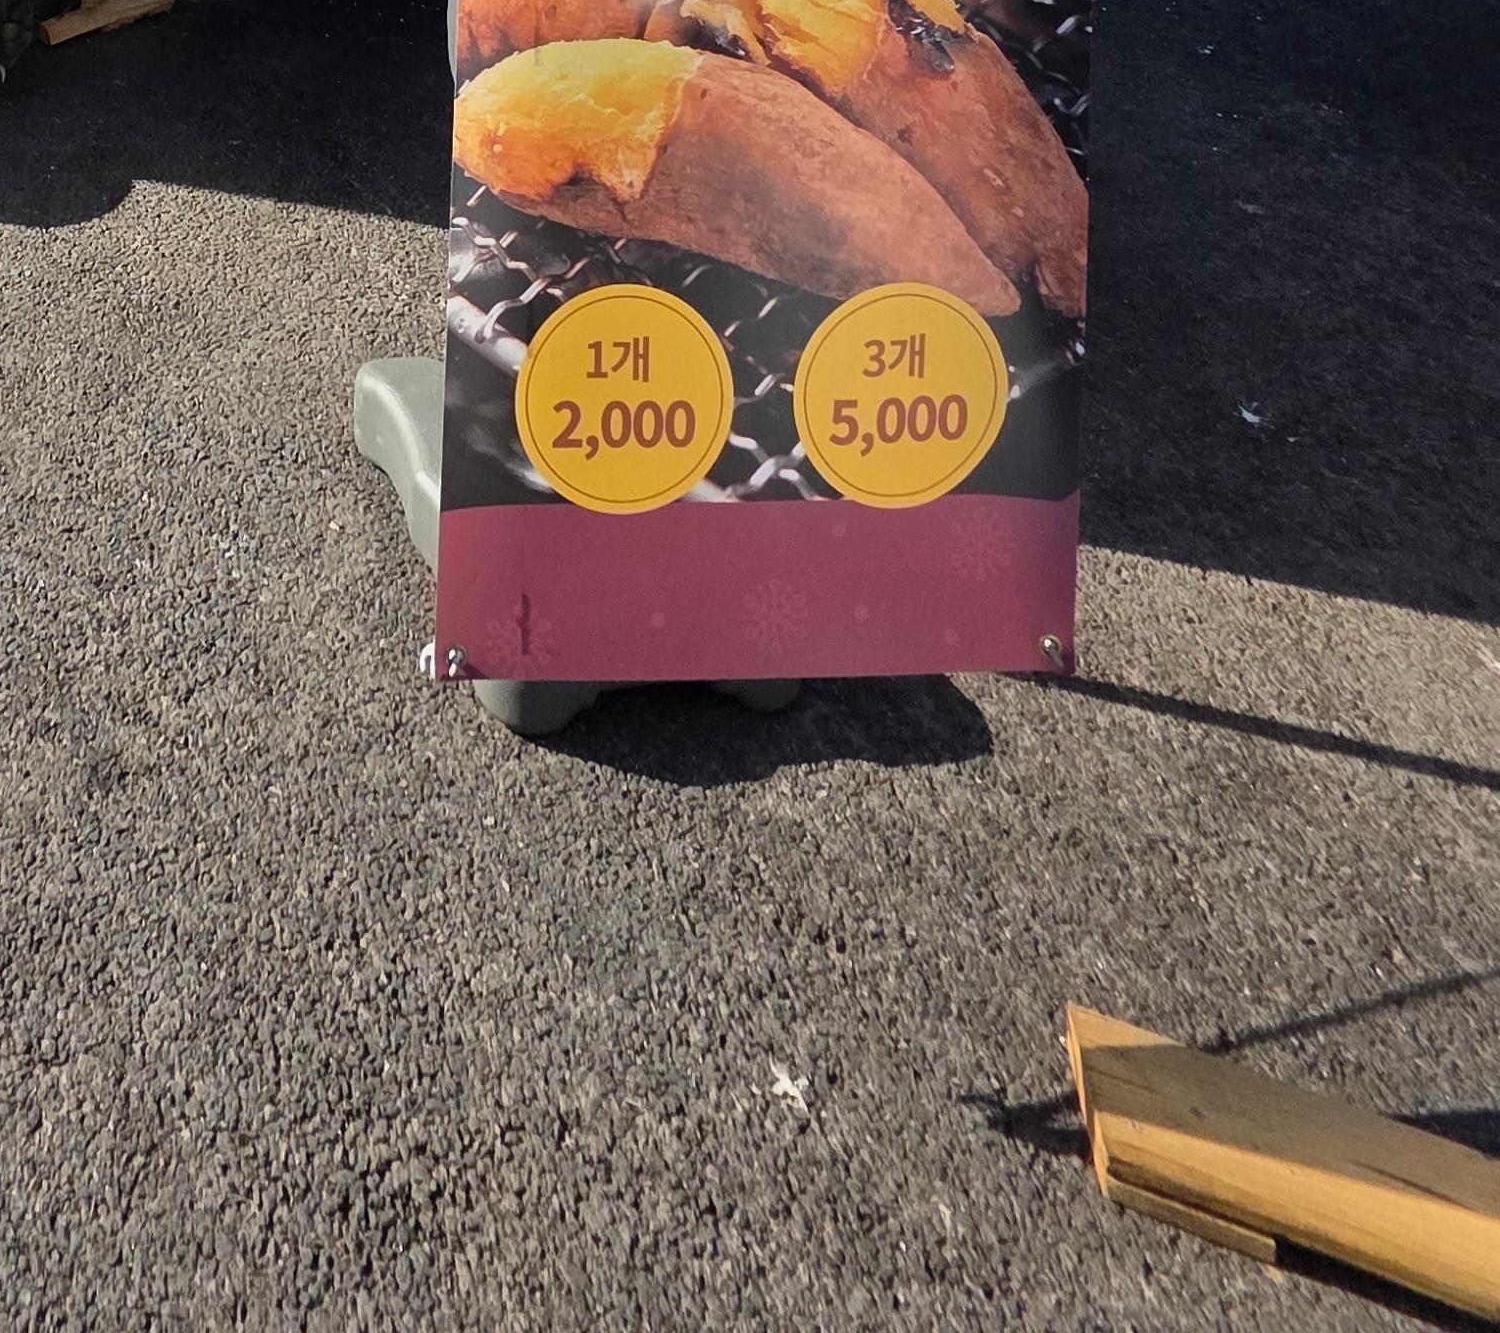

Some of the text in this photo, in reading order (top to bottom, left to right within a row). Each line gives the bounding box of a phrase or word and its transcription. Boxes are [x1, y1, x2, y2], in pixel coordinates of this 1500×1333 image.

[585, 334, 651, 383] 1개
[862, 331, 928, 381] 3개
[551, 397, 696, 459] 2,000
[828, 394, 968, 457] 5,000
